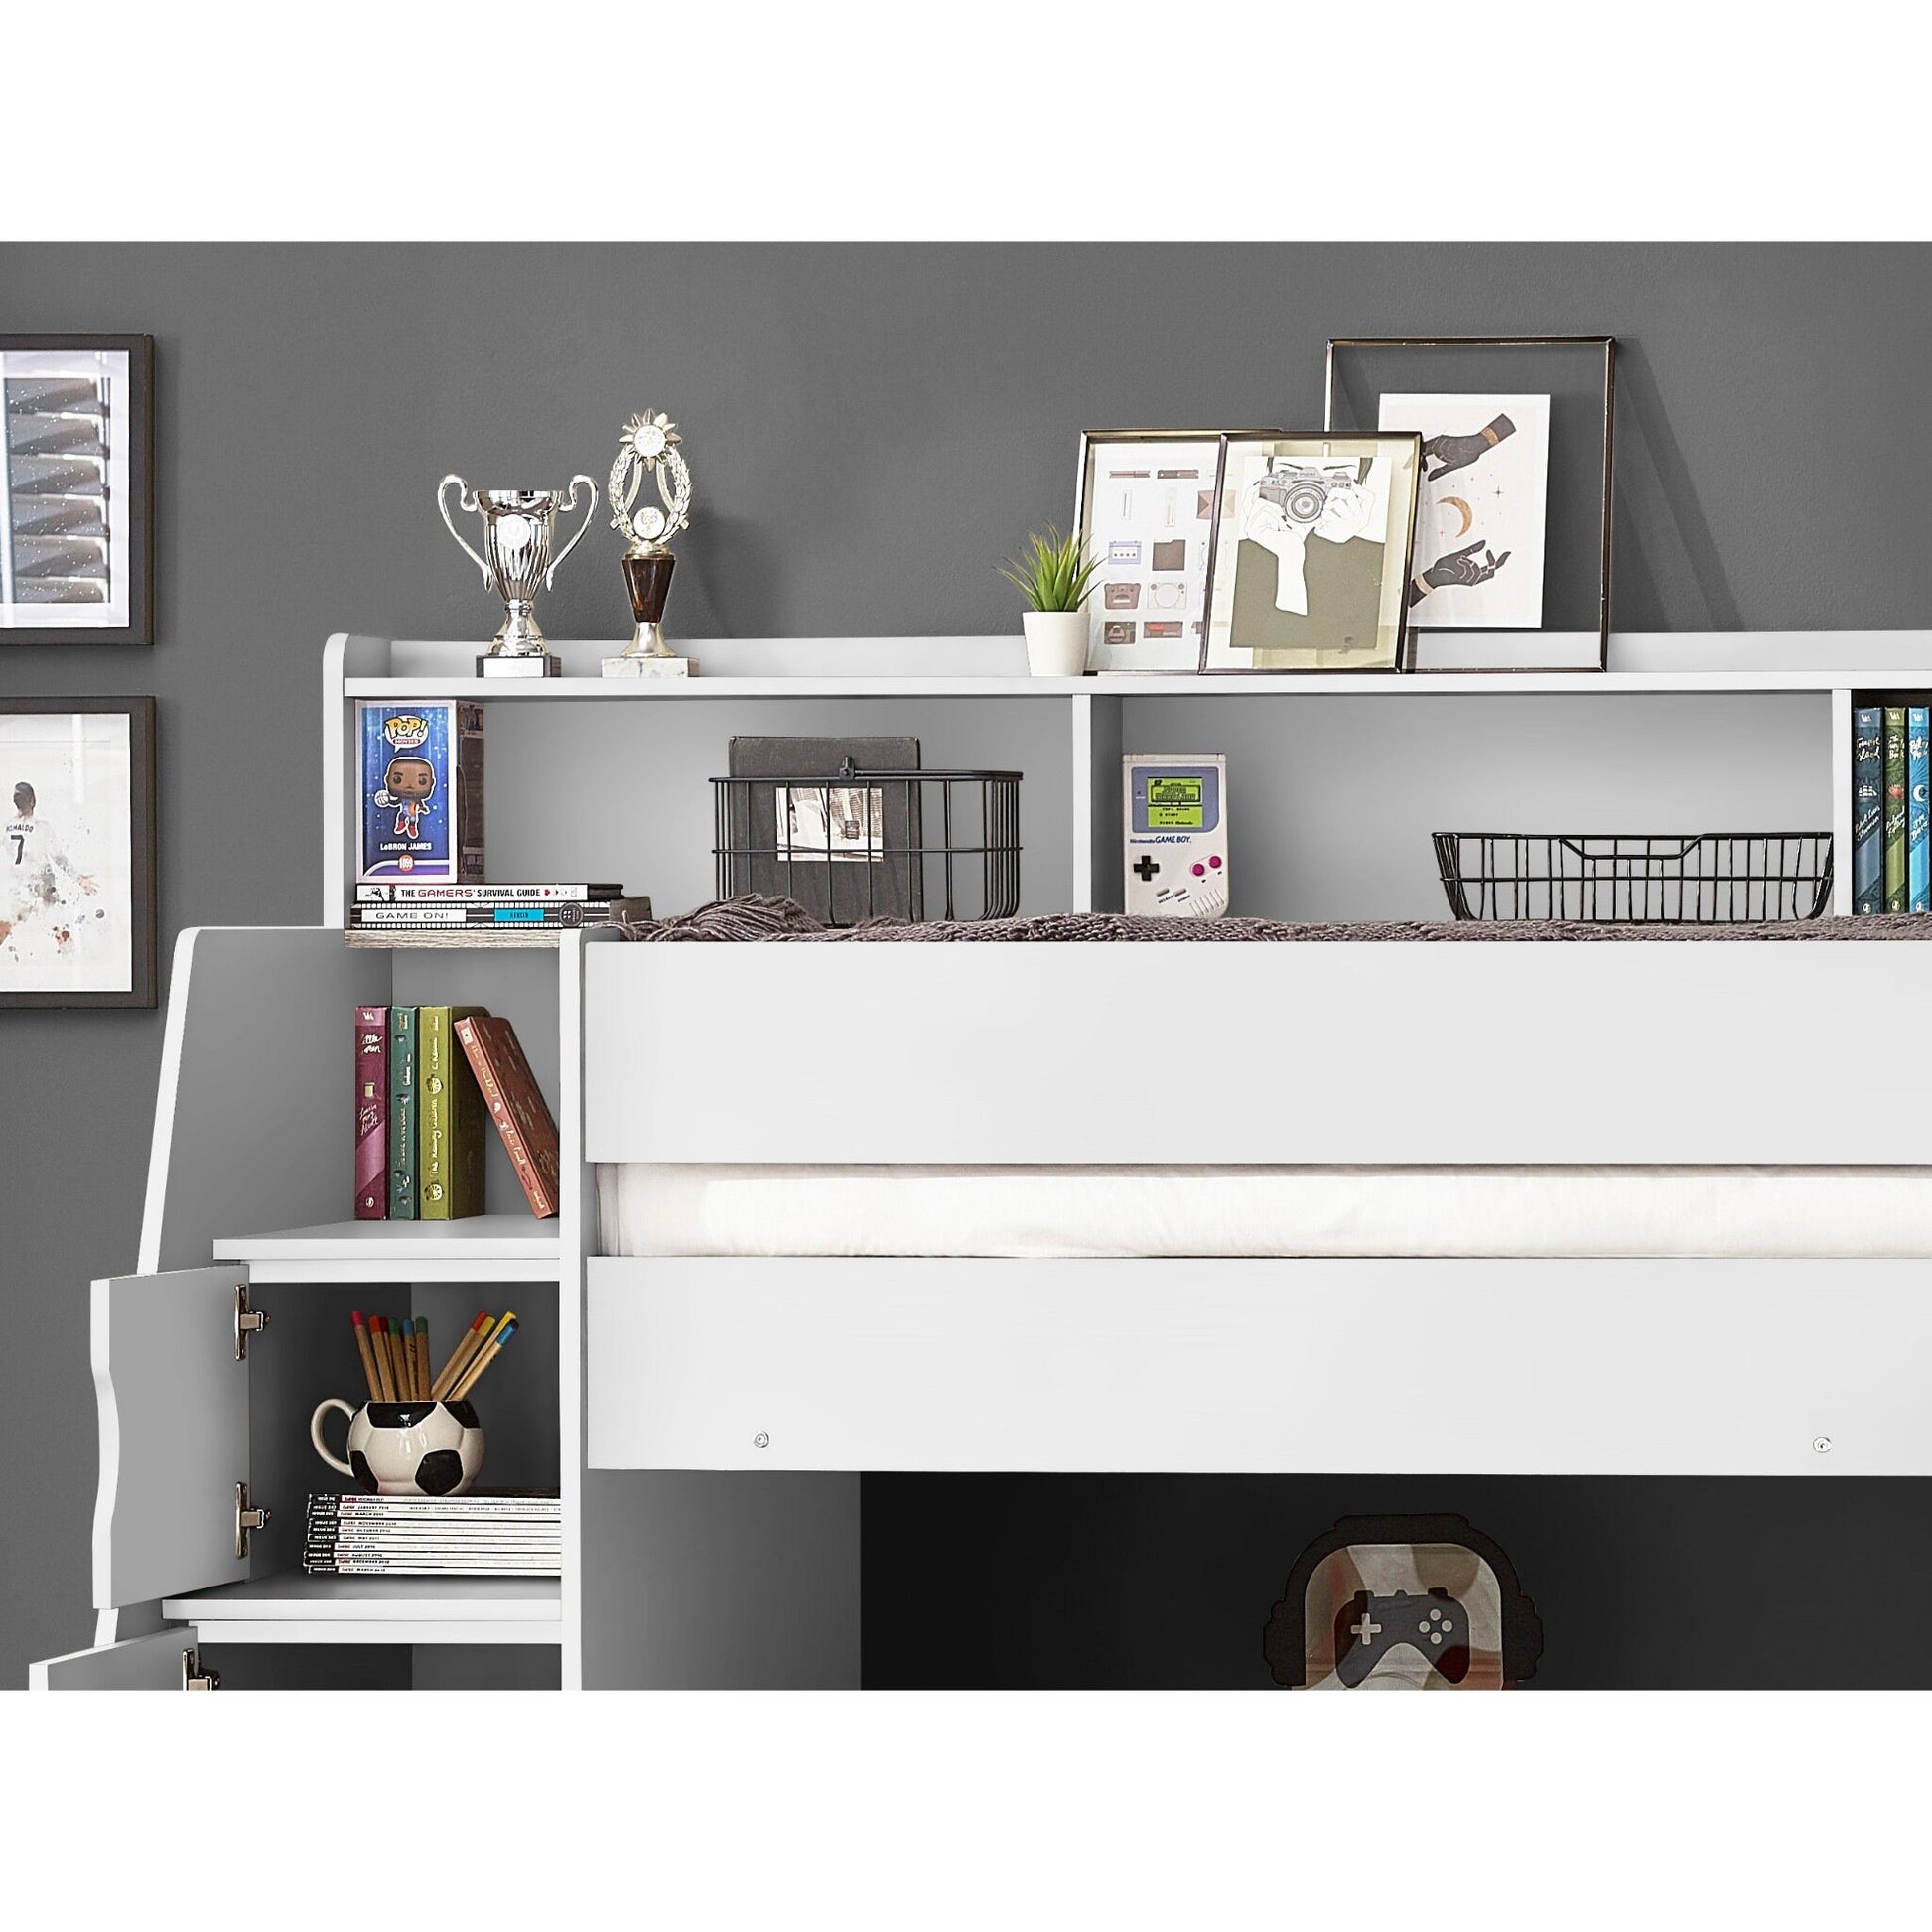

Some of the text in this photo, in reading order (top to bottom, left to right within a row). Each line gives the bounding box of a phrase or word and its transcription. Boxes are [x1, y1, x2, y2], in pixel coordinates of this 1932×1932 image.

[384, 717, 428, 739] POP!
[1155, 835, 1175, 844] GAME
[1176, 835, 1191, 844] BOY
[10, 834, 25, 865] 7
[379, 842, 433, 851] LeBRON JAMES
[401, 888, 541, 897] THE GAMERS' SURVIVAL GUIDE
